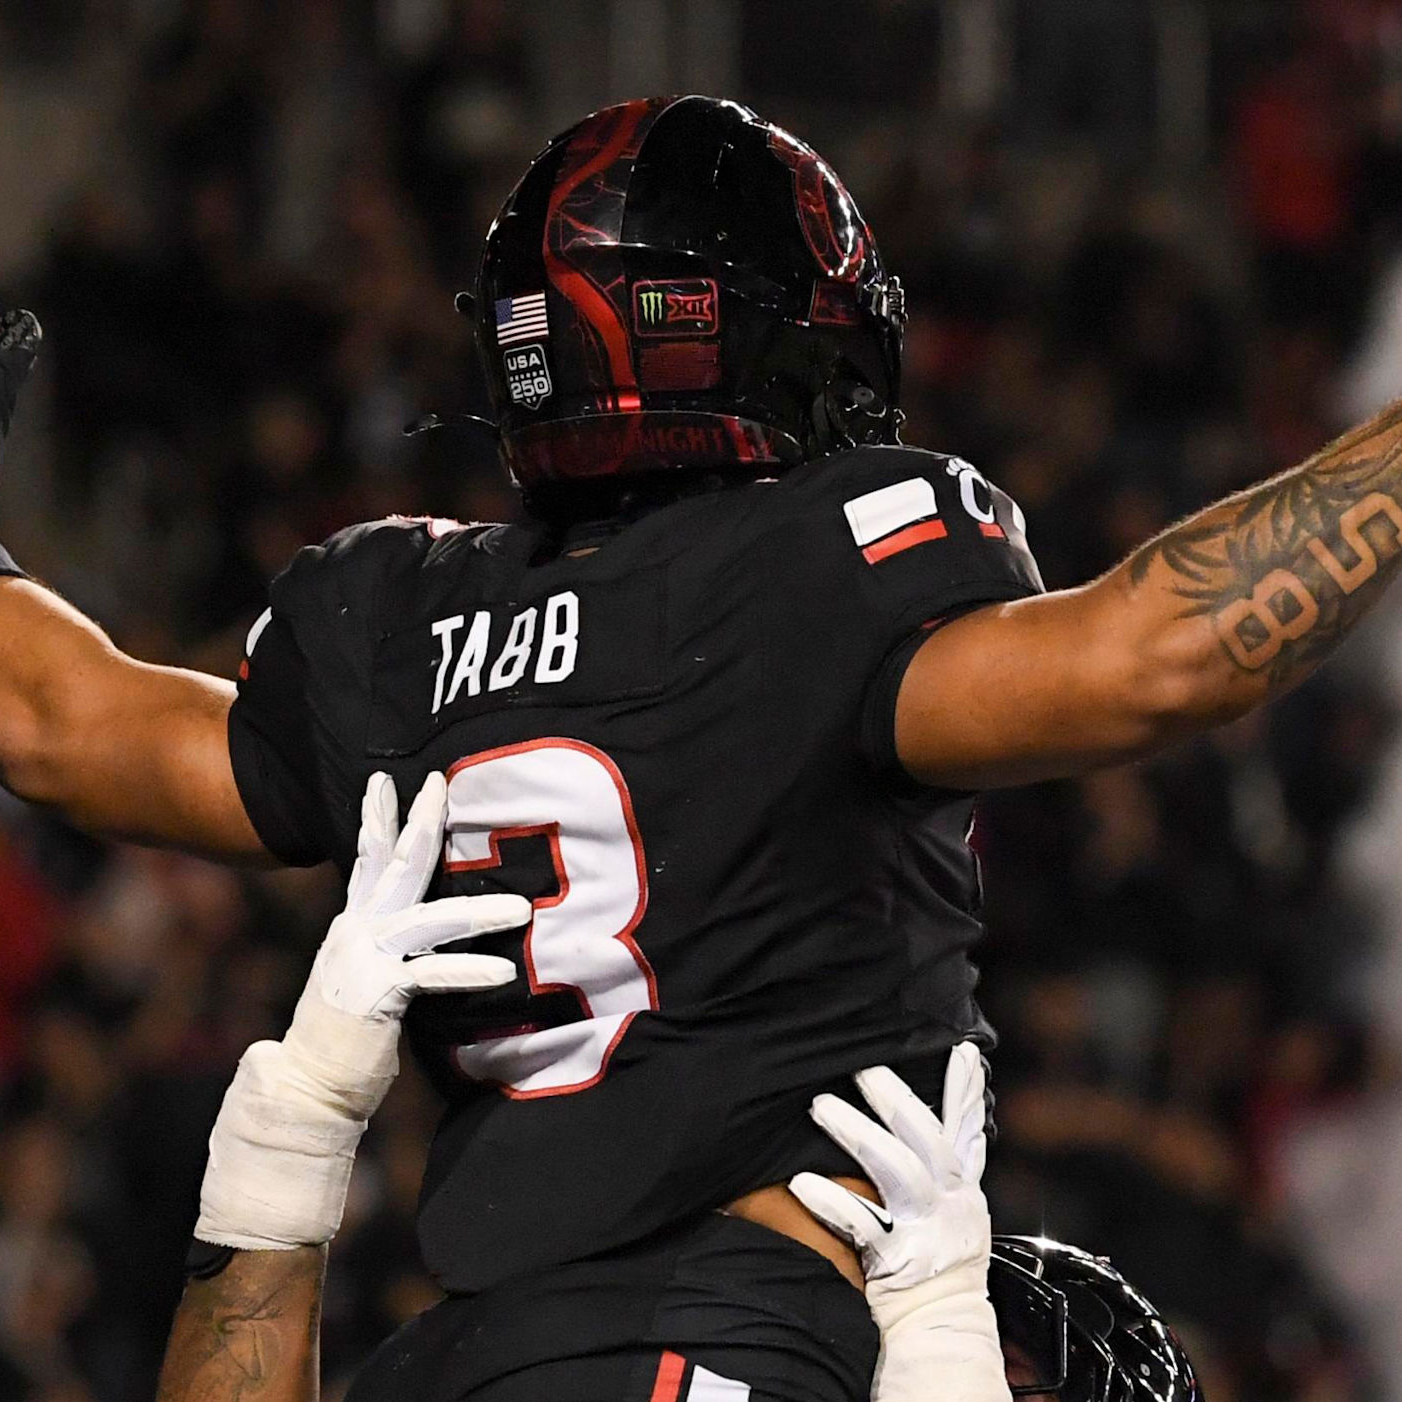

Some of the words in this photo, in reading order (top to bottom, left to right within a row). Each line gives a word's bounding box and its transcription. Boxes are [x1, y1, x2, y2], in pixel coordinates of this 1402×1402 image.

[507, 352, 542, 371] USA
[510, 376, 549, 400] 250
[430, 590, 579, 714] TABB
[443, 736, 661, 1100] 3
